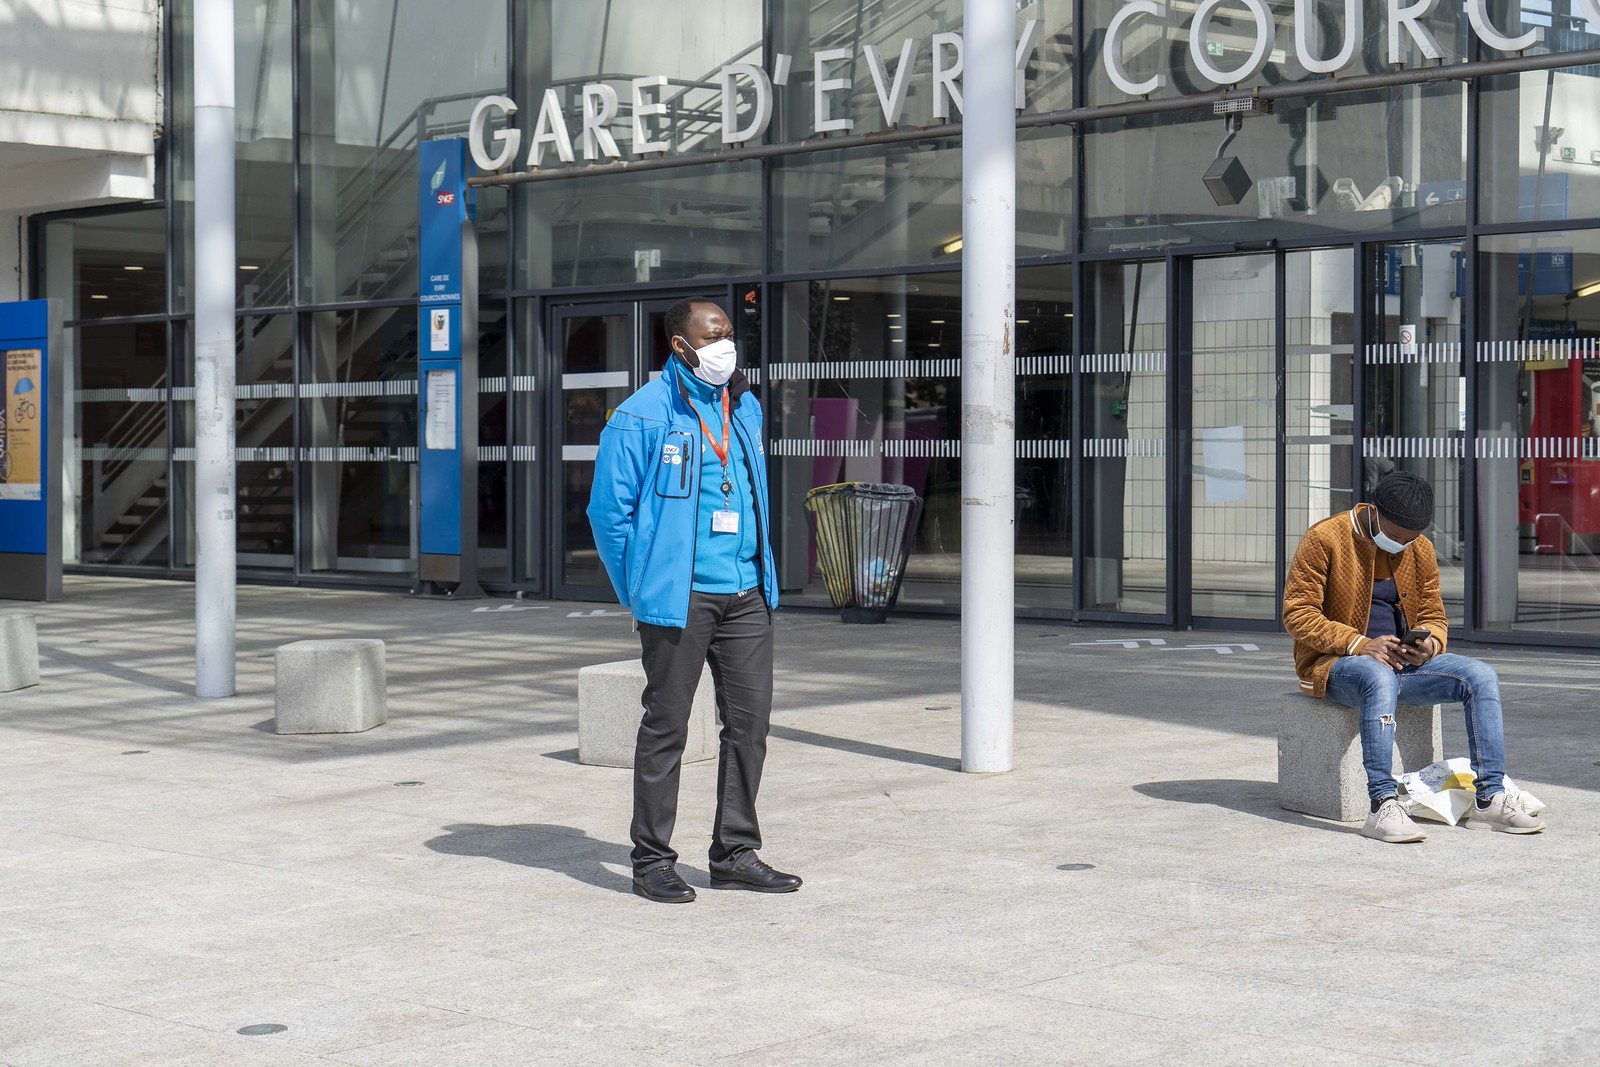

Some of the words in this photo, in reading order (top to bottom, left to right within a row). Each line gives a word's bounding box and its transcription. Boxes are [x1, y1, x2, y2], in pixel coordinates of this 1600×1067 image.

[468, 75, 668, 171] GARE
[1103, 0, 1600, 96] COURC
[437, 194, 454, 204] SNCF
